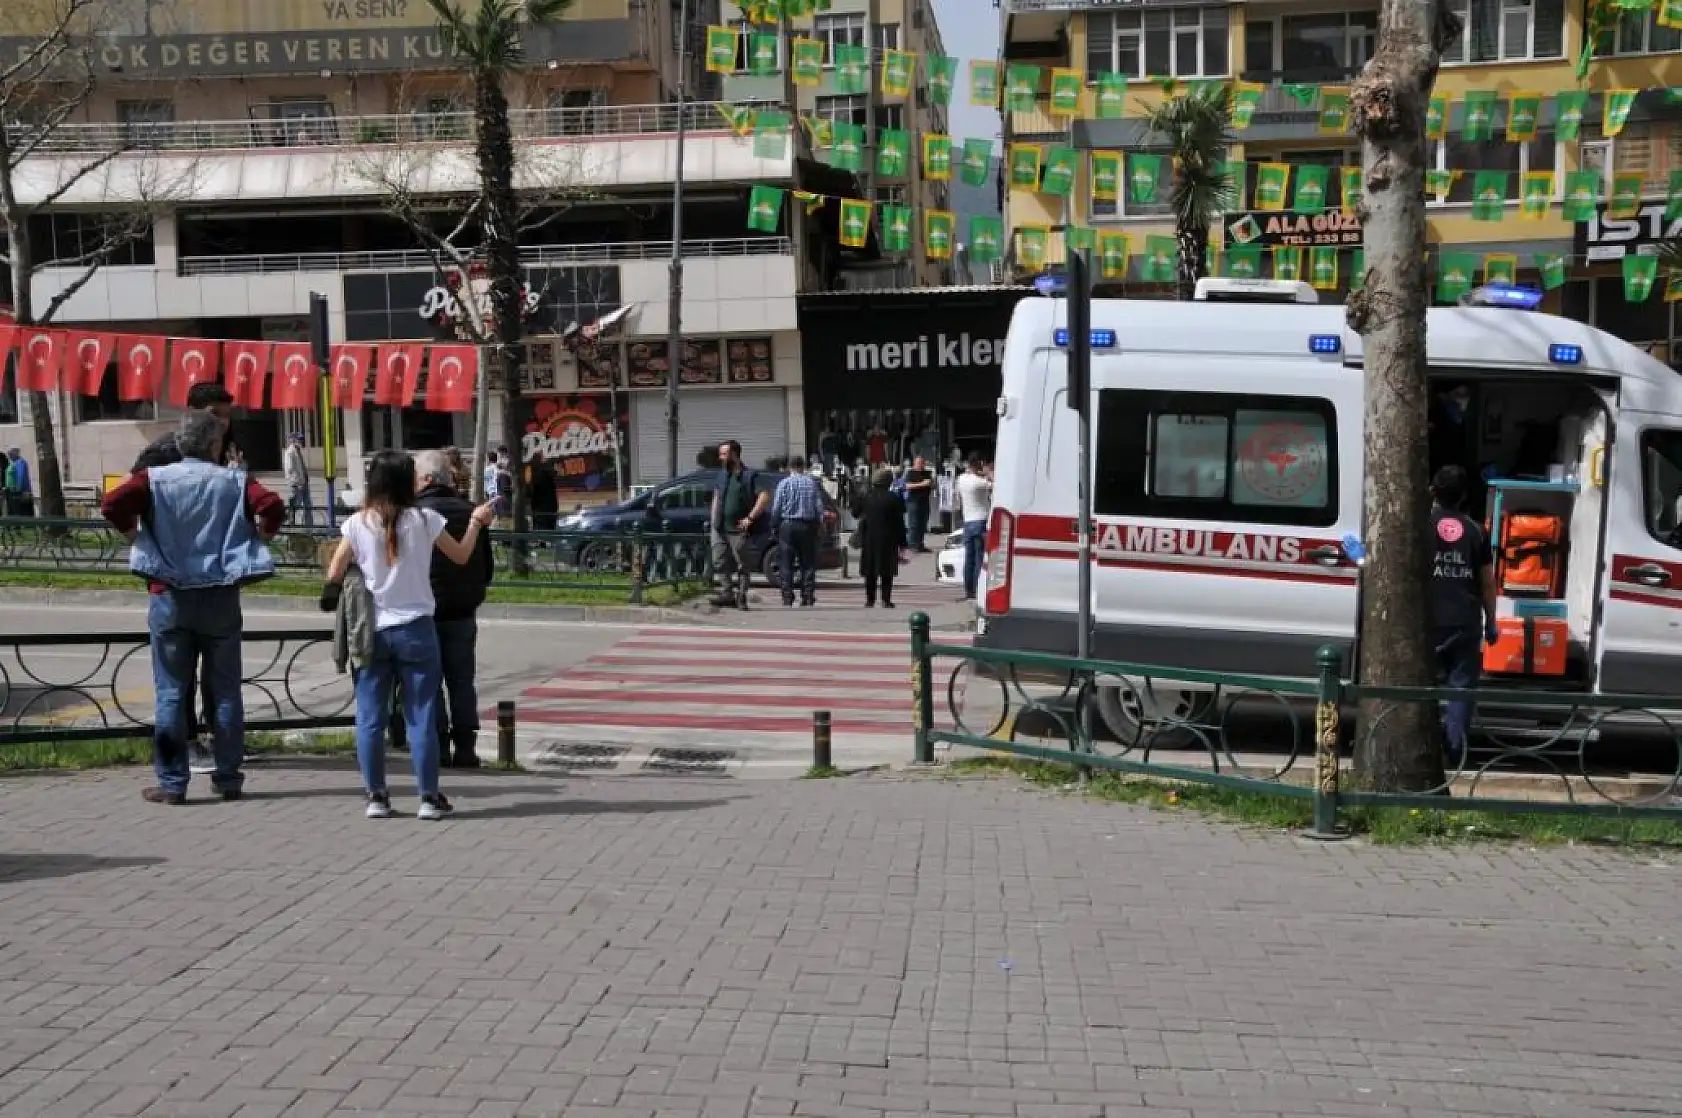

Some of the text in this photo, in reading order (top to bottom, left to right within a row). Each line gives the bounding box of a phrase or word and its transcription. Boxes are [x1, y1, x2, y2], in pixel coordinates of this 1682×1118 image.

[324, 0, 407, 21] YA SEN?
[160, 37, 270, 67] DEĞER
[283, 36, 390, 63] VEREN
[846, 336, 928, 371] meri
[1097, 523, 1301, 564] AMBULANS
